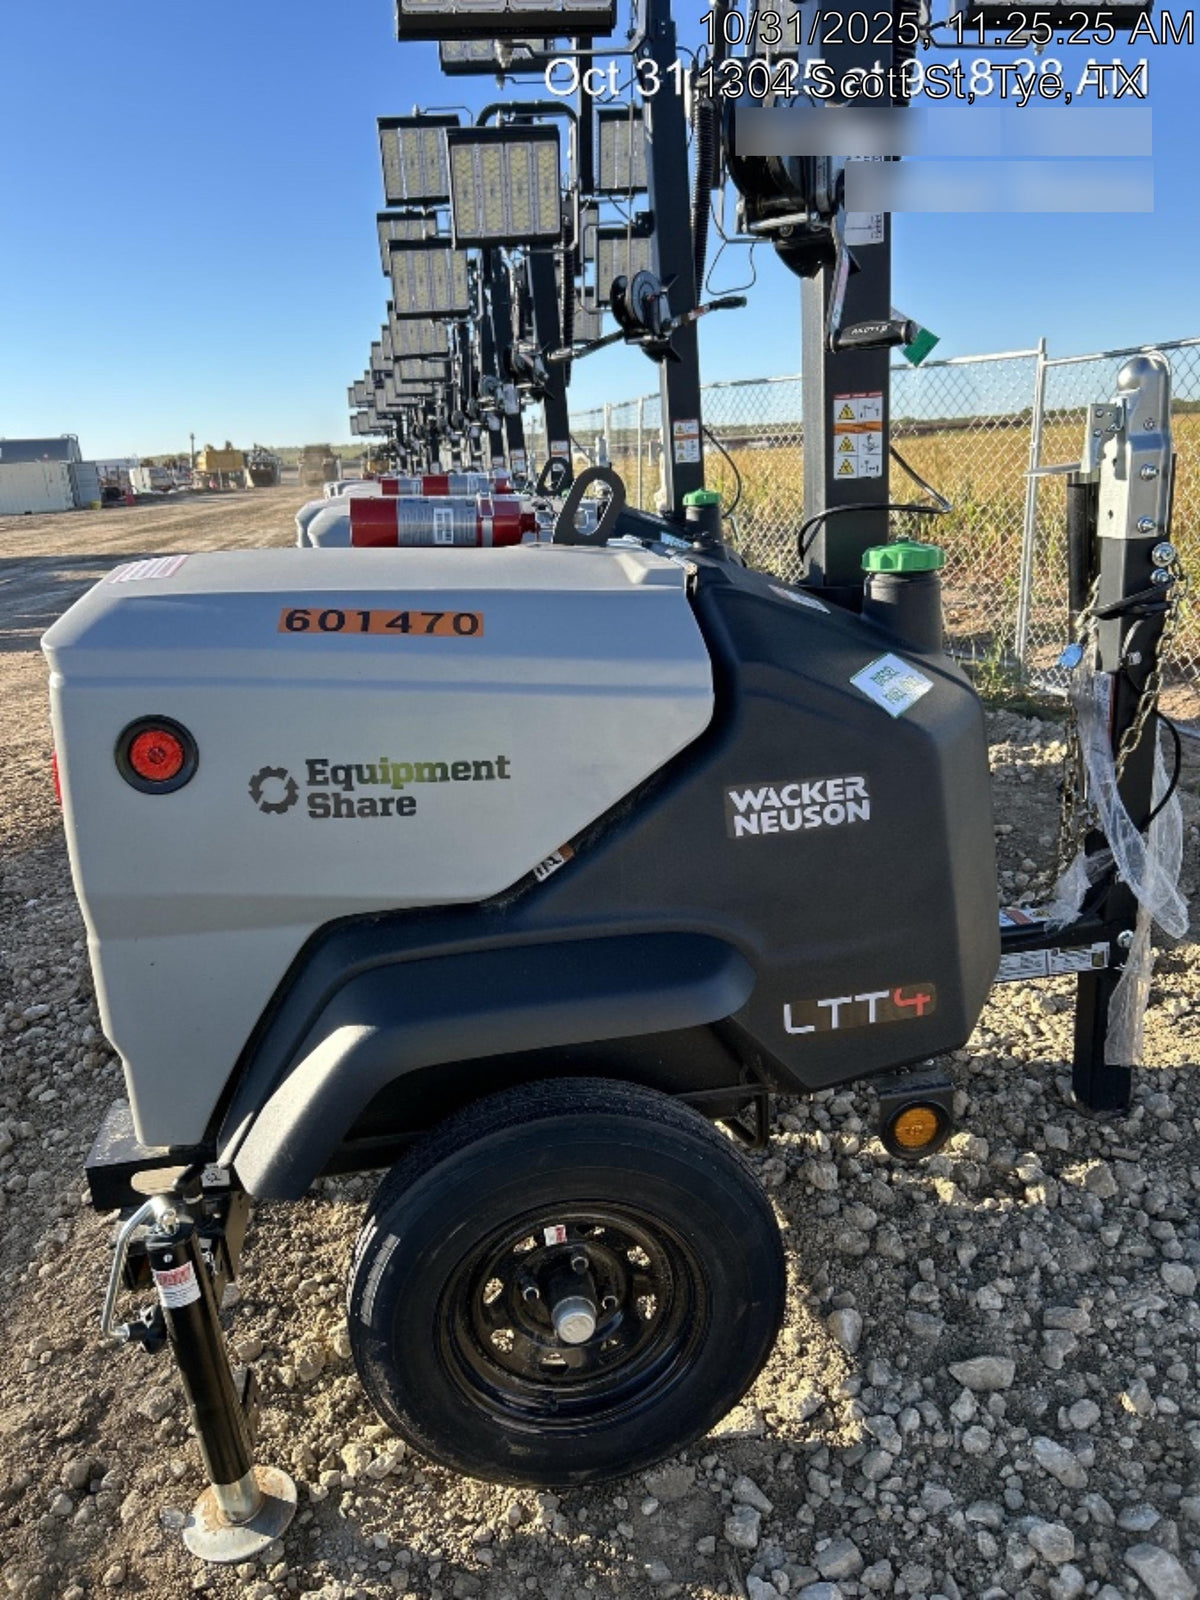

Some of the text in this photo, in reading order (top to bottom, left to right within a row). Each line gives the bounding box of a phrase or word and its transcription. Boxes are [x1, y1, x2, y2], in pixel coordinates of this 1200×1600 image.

[285, 609, 479, 635] 601470
[305, 755, 511, 791] Equipment
[307, 792, 417, 818] Share
[728, 776, 870, 813] WACKER
[733, 799, 870, 837] NEUSON
[783, 988, 931, 1034] LTT4
